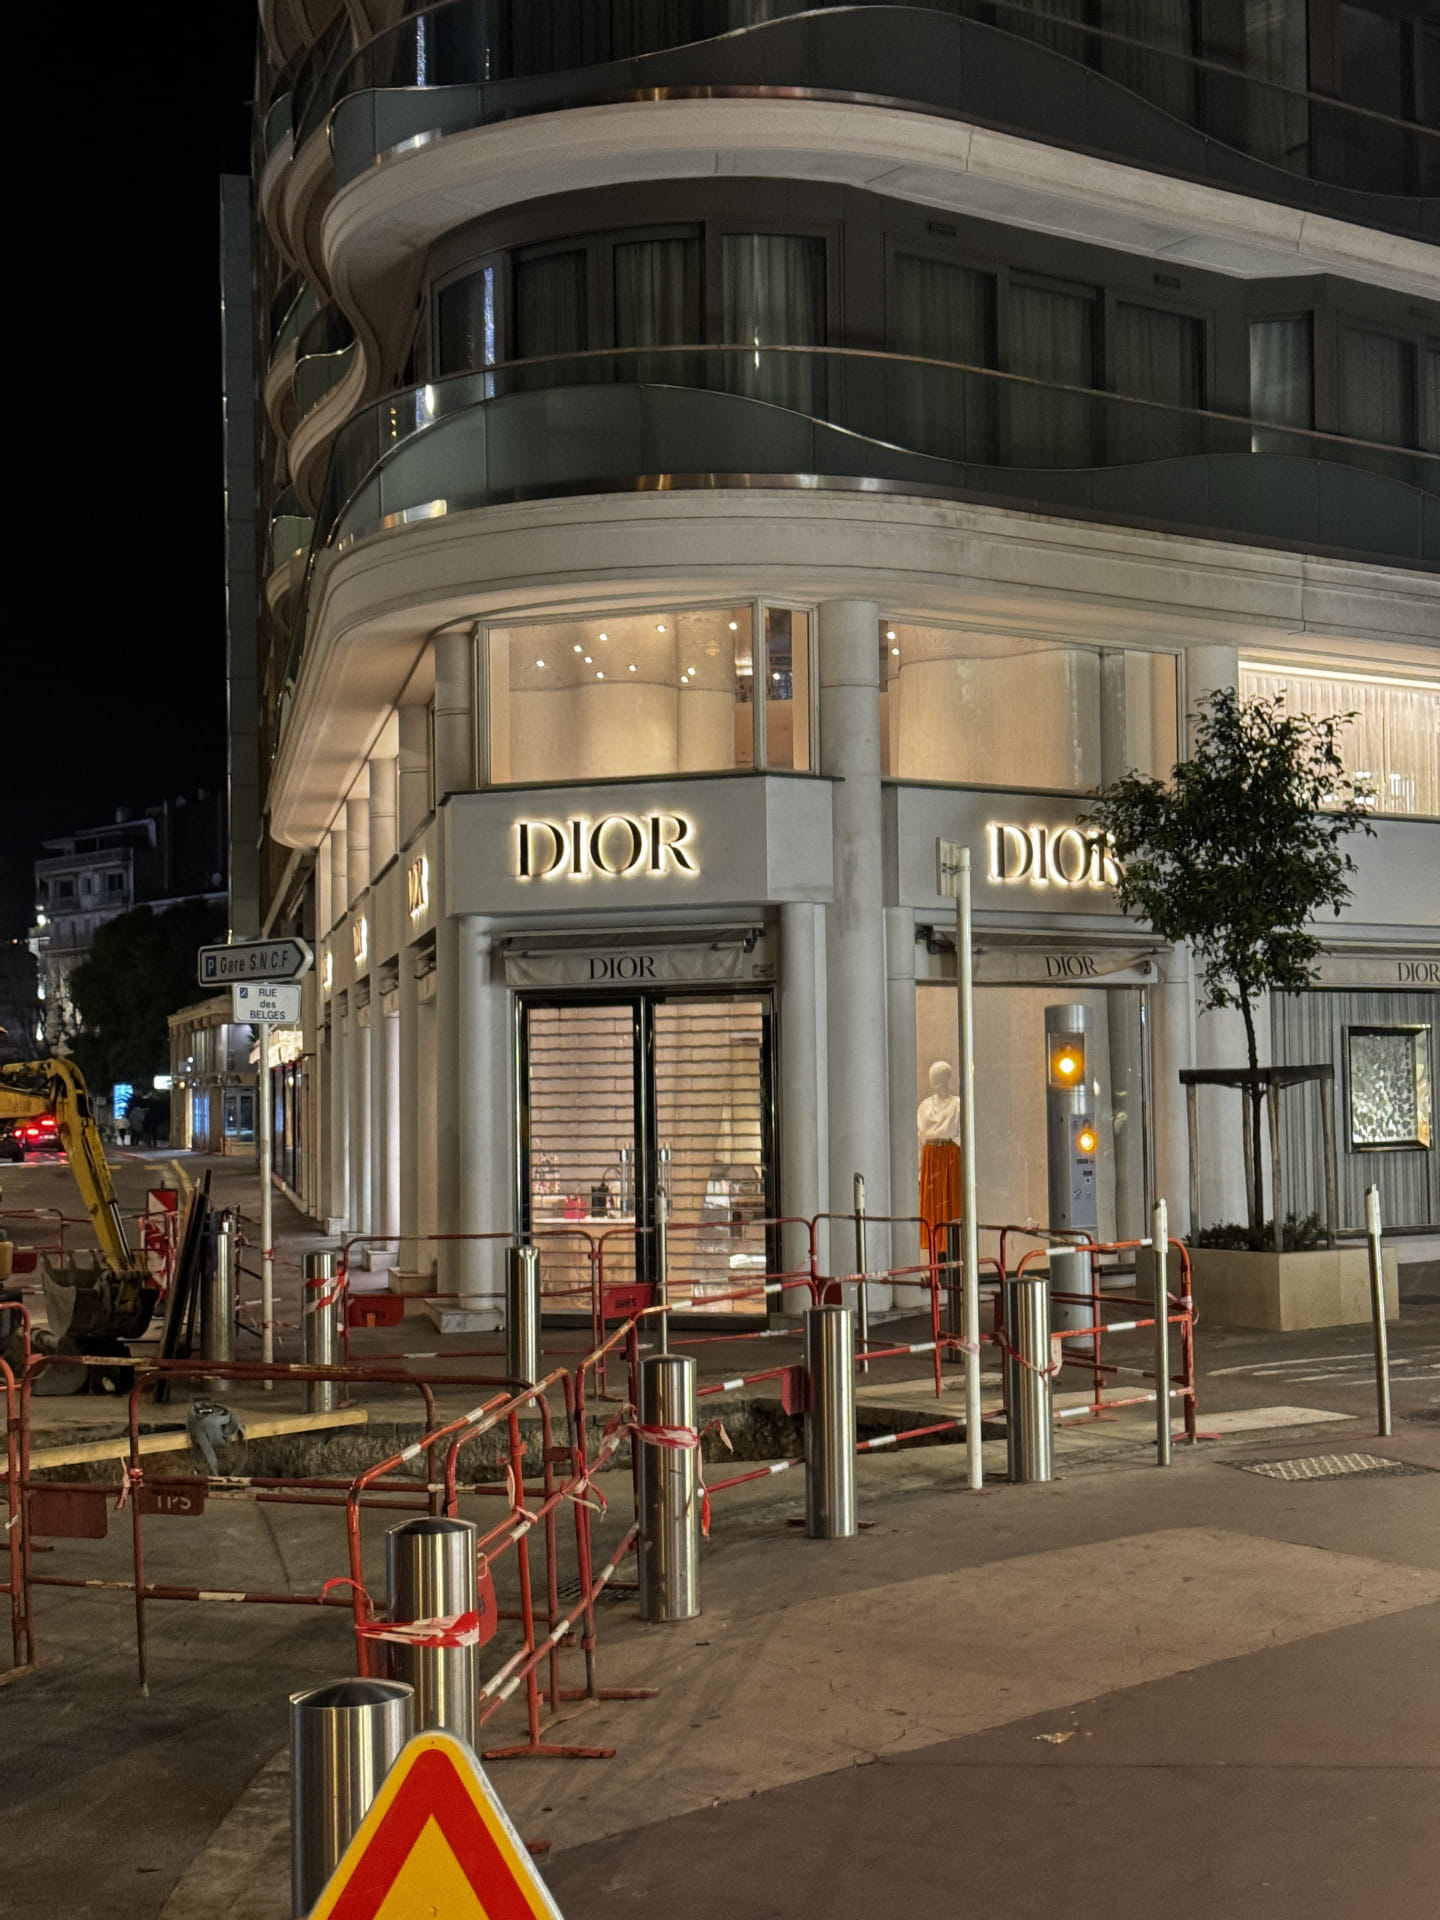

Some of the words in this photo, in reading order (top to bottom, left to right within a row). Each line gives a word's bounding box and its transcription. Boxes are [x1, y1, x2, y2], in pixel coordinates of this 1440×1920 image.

[514, 815, 698, 876] DIOR
[220, 956, 246, 974] Gare
[589, 955, 656, 979] DIOR
[1045, 956, 1099, 977] DIOR
[1398, 962, 1440, 982] DIOR
[258, 988, 278, 998] RUE
[260, 1000, 277, 1009] des
[250, 1010, 286, 1021] BELGES
